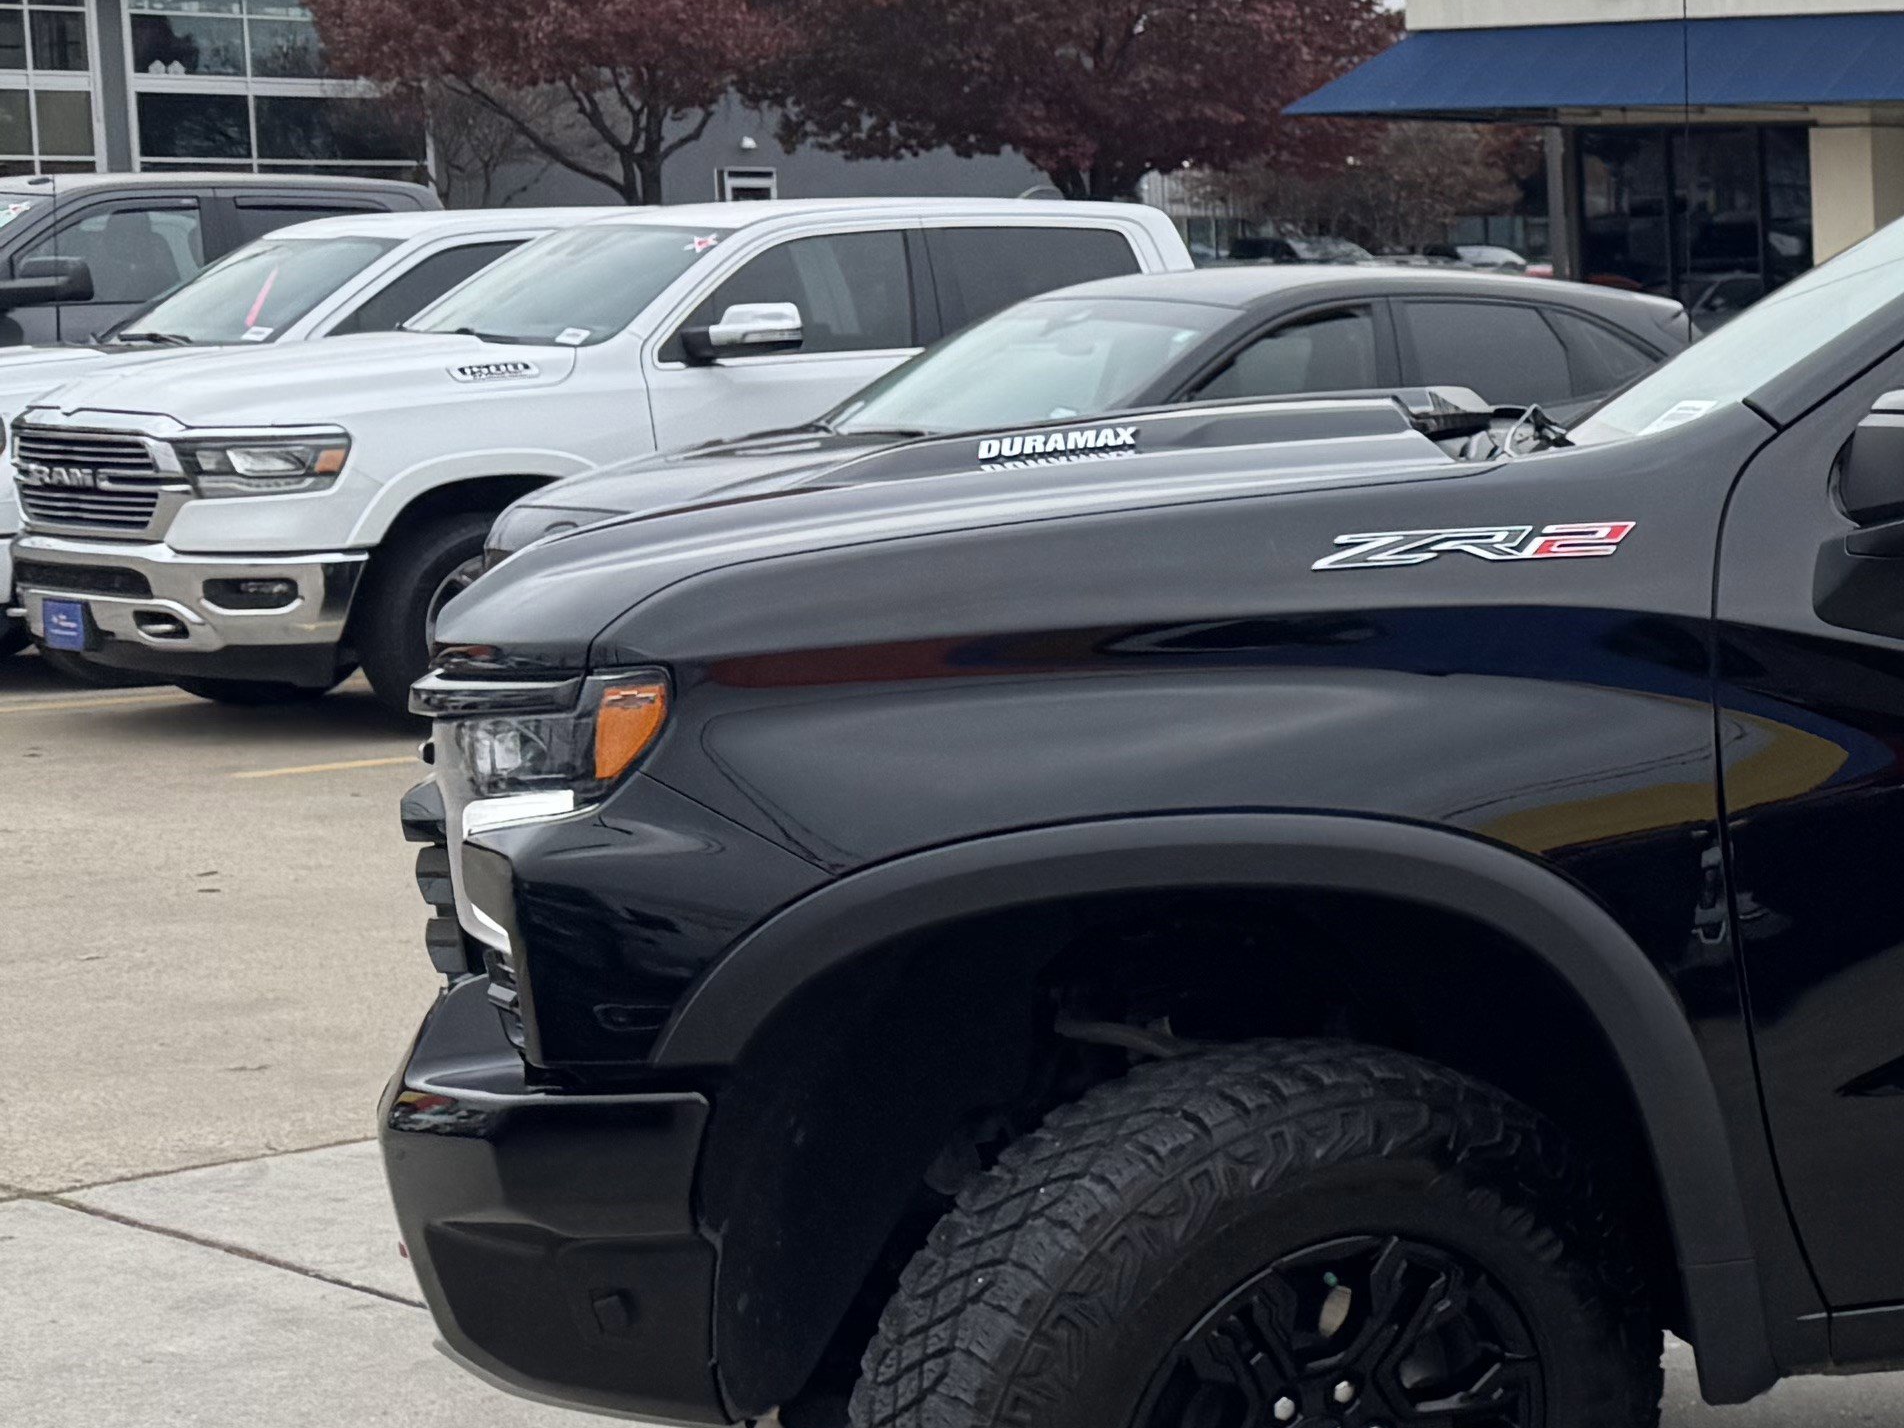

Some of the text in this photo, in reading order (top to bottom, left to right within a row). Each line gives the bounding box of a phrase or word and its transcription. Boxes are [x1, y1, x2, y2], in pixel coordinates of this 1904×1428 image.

[978, 426, 1136, 459] DURAMAX
[33, 465, 94, 487] RAM
[1311, 521, 1637, 572] ZR2
